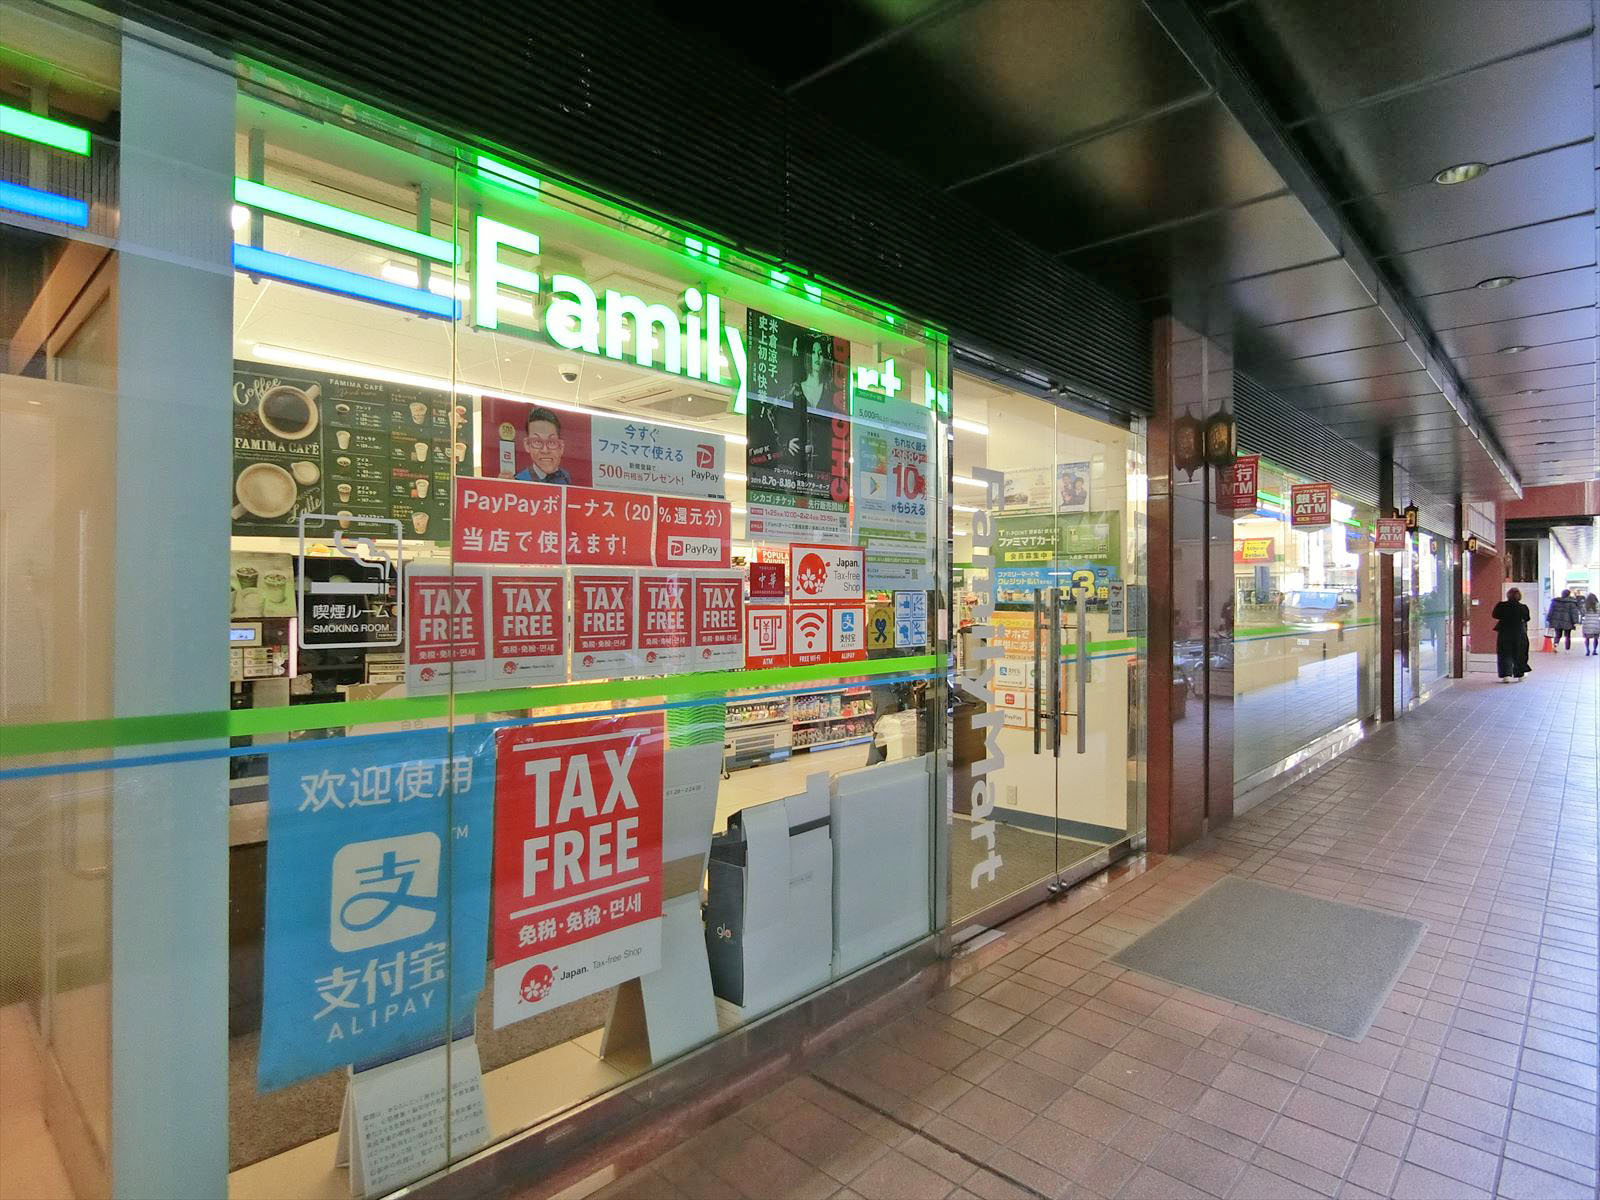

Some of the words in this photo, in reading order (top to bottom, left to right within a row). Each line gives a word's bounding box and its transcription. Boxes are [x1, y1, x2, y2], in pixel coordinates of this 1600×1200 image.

[233, 377, 281, 406] Coffee
[329, 378, 361, 389] FAMIMA
[624, 424, 660, 442] 今すぐ
[235, 437, 285, 453] FAMIMA
[289, 442, 319, 455] CAFÉ
[598, 438, 685, 462] ファミマで使える
[691, 469, 719, 483] PayPay
[1236, 468, 1252, 482] 行
[1296, 493, 1327, 505] 銀行
[1295, 503, 1327, 515] ATM
[463, 527, 627, 556] 当店で使えます!
[998, 533, 1059, 547] ファミマTカード
[1379, 533, 1402, 541] ATM
[685, 542, 718, 555] PayPay
[837, 557, 860, 568] Japan.
[834, 570, 860, 581] Tax-free
[843, 582, 860, 593] Shop
[419, 589, 472, 615] TAX
[502, 588, 552, 613] TAX
[583, 587, 625, 610] TAX
[647, 587, 685, 609] TAX
[703, 588, 735, 608] TAX
[313, 604, 389, 620] 喫煙ルーム
[647, 611, 685, 630] FREE
[703, 610, 736, 628] FREE
[313, 623, 359, 634] SMOKING
[360, 623, 390, 632] ROOM
[419, 617, 473, 641] FREE
[503, 615, 553, 637] FREE
[583, 612, 625, 632] FREE
[298, 755, 473, 813] 欢迎使用
[524, 745, 640, 829] TAX
[522, 816, 640, 899] FREE
[560, 966, 589, 982] Japan.
[592, 953, 622, 970] Tax-free
[623, 946, 643, 959] Shop
[313, 942, 447, 1022] 支付宝
[327, 989, 435, 1043] ALIPAY
